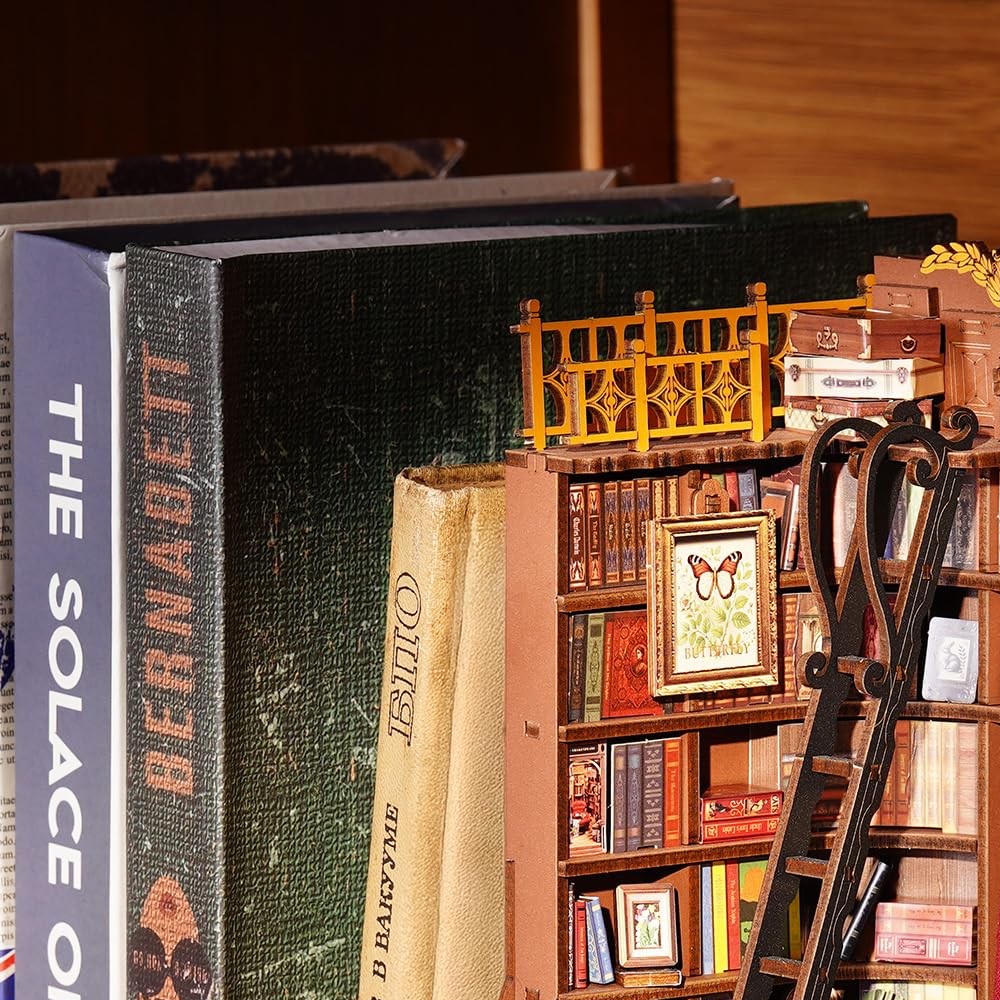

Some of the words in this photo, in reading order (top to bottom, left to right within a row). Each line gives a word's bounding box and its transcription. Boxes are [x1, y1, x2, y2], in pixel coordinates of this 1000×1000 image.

[48, 383, 84, 540] THE
[143, 341, 194, 797] BERNADETT
[387, 571, 422, 747] БПО
[684, 641, 750, 660] BUTTERFLY
[47, 572, 84, 891] SOLACE
[771, 794, 779, 813] CATS
[375, 802, 399, 953] ВАКУУМЕ
[372, 959, 388, 983] В
